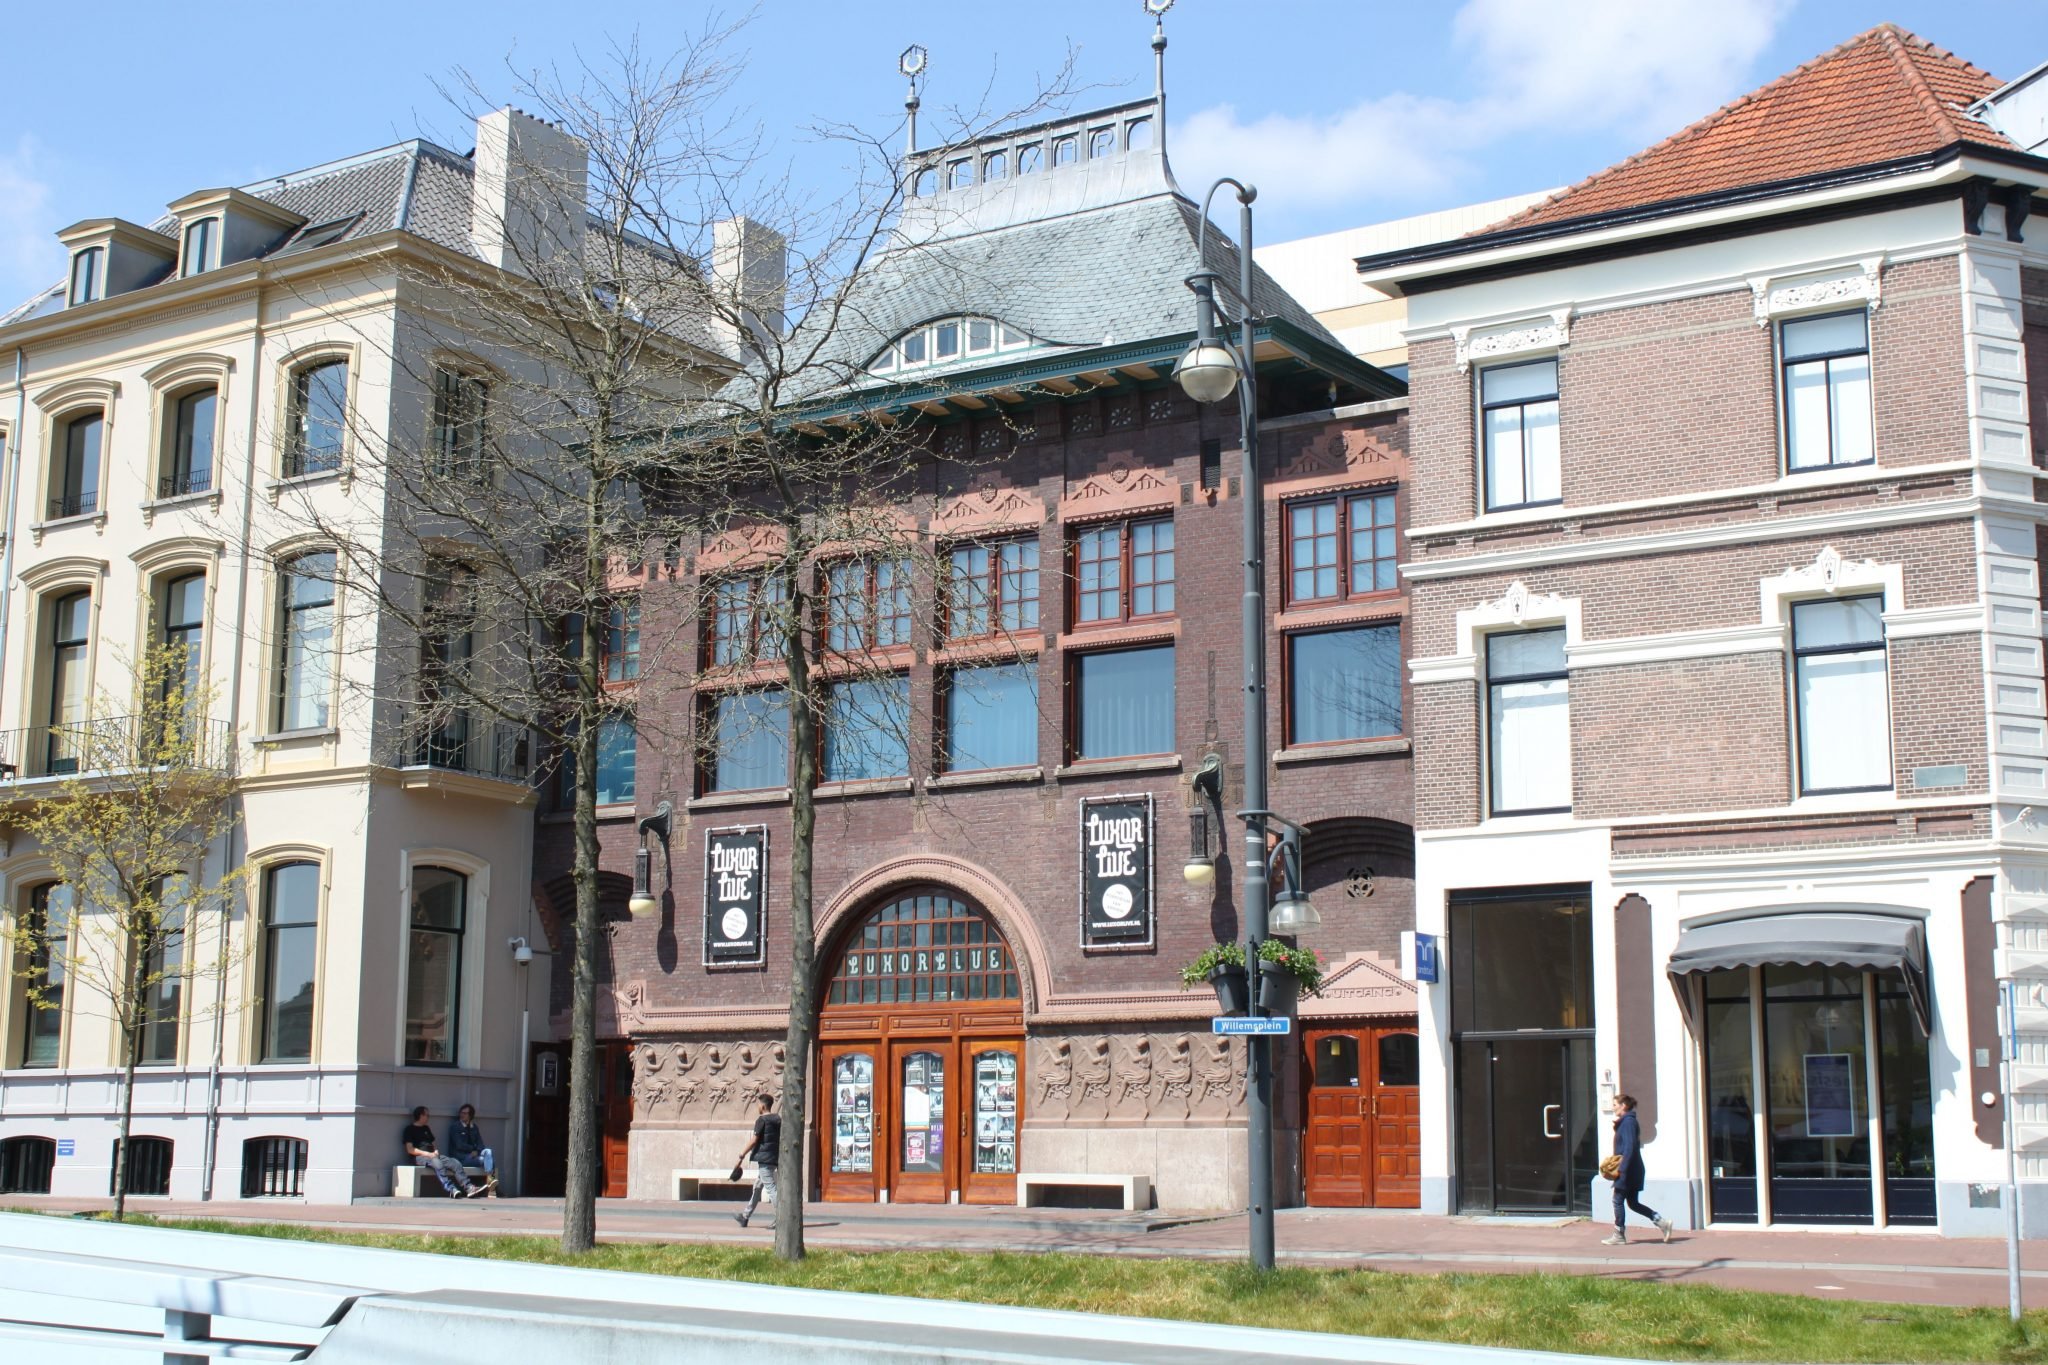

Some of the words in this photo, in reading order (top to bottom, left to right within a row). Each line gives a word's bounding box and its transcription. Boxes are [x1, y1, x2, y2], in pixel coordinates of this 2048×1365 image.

[1086, 814, 1143, 851] LUXOR
[711, 843, 758, 878] LUXOR
[1221, 1021, 1282, 1031] Willemsplein
